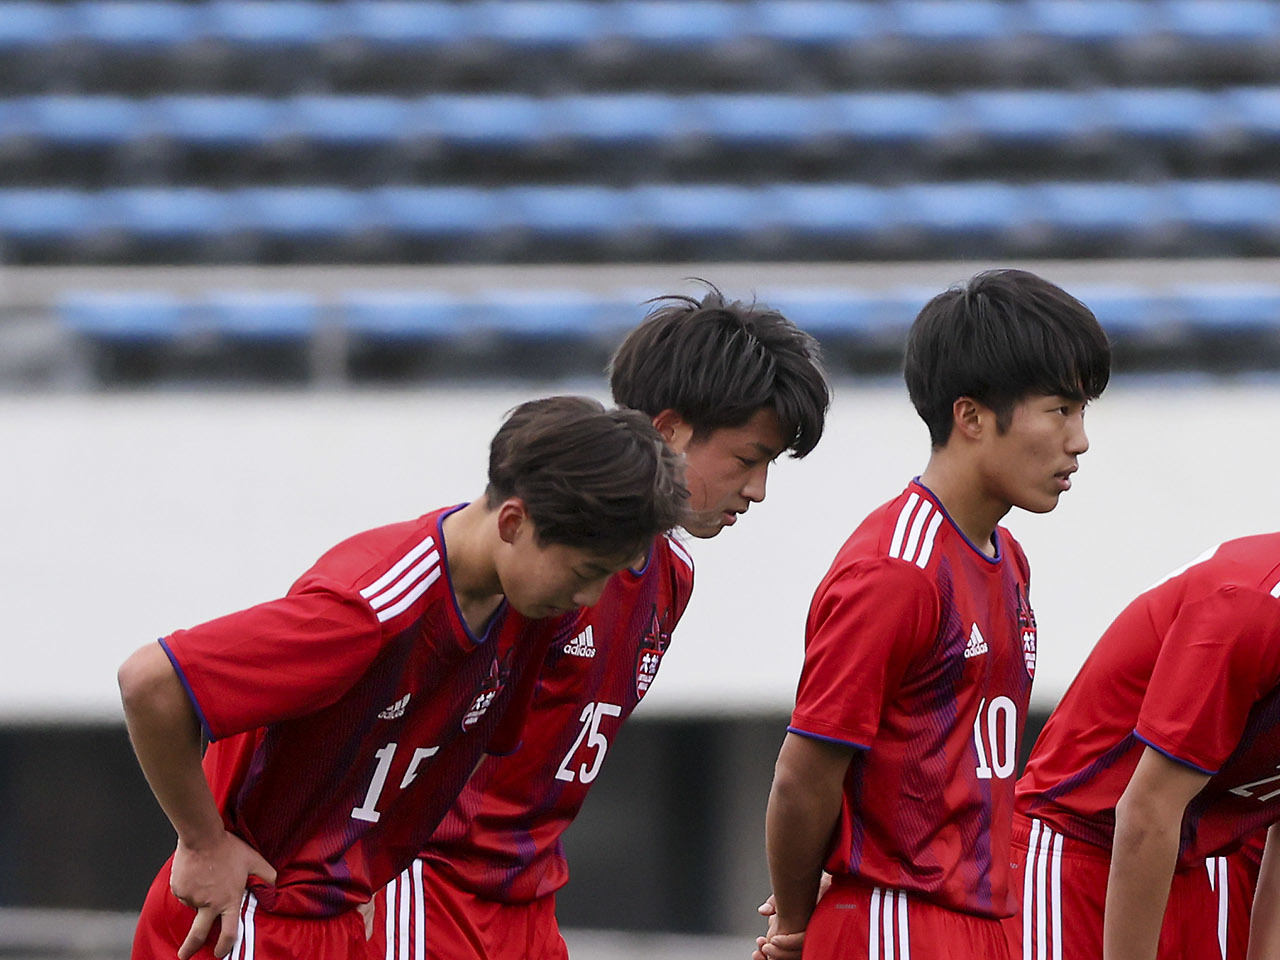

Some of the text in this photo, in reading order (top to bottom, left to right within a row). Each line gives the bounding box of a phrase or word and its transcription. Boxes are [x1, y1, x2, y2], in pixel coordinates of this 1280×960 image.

[563, 644, 597, 658] adidas
[964, 642, 989, 659] adidas
[555, 701, 622, 784] 25
[973, 695, 1018, 779] 10
